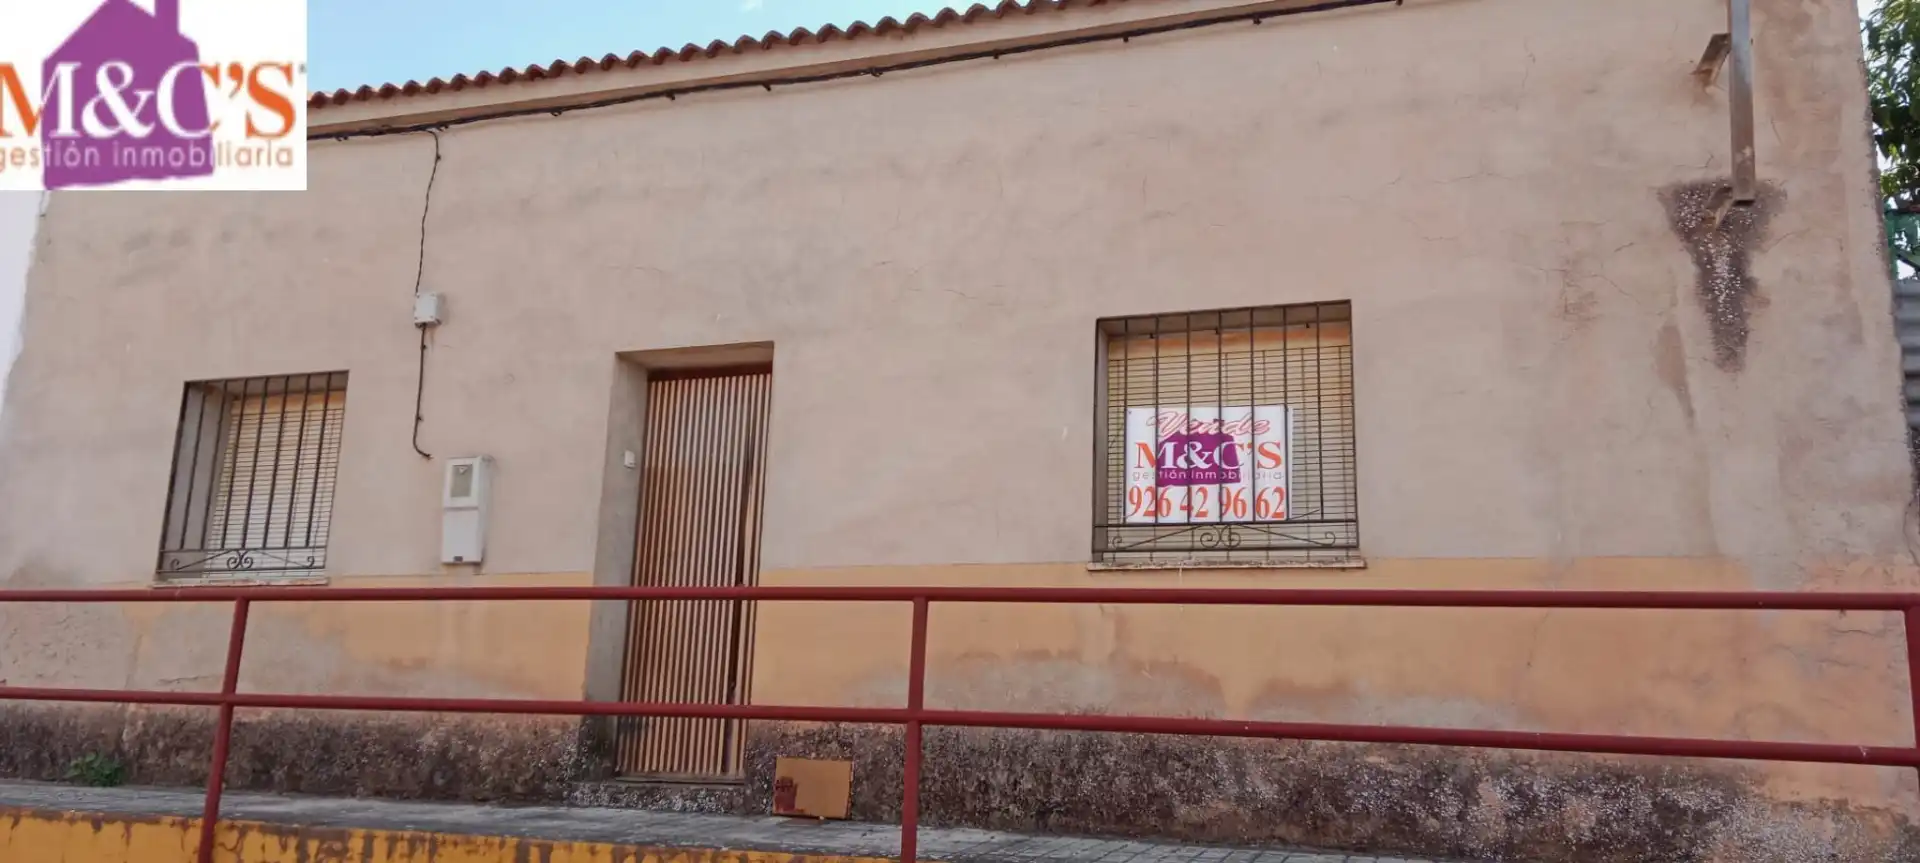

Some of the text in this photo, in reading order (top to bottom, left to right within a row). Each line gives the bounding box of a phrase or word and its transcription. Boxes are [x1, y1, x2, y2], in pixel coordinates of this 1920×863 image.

[1146, 411, 1270, 442] Vende
[1134, 441, 1282, 469] M&C'S
[1126, 485, 1285, 519] 926 42 96 62
